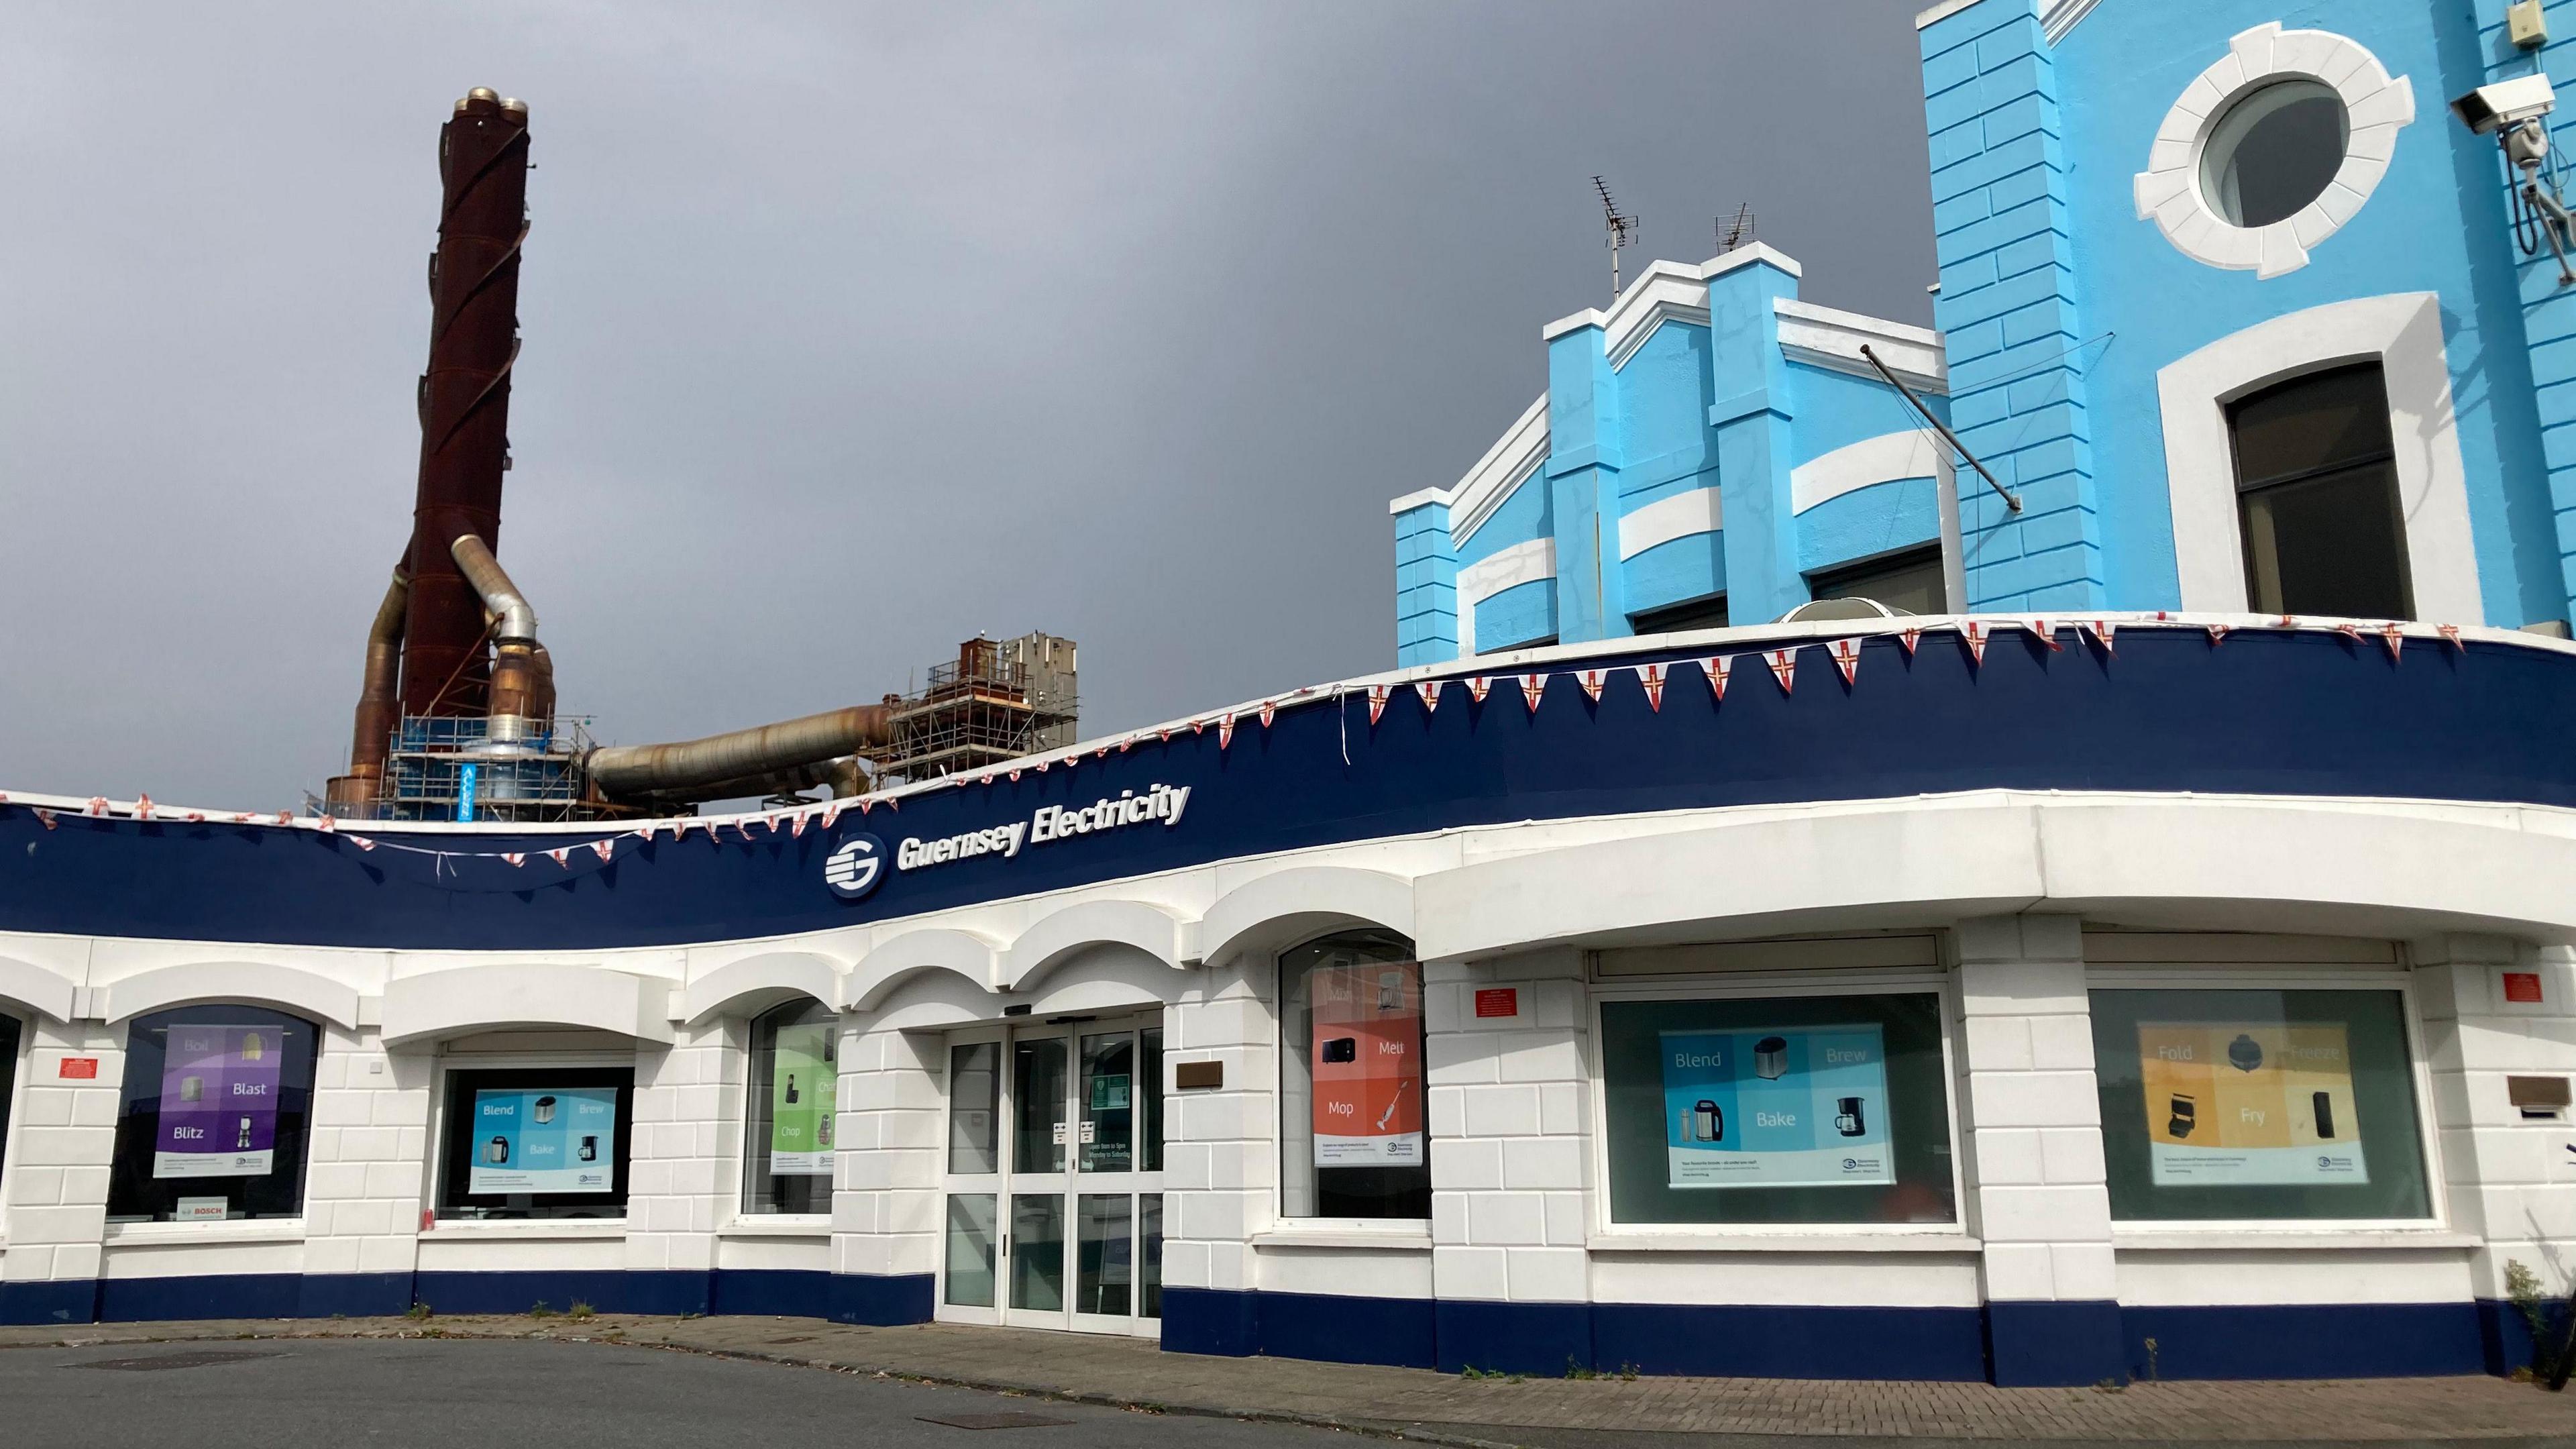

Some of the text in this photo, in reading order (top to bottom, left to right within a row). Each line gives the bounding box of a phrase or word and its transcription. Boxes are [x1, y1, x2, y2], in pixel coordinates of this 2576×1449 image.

[898, 784, 1191, 870] Guernsey Electricity
[184, 1040, 208, 1051] Boil
[1379, 1042, 1404, 1055] Melt
[1826, 1049, 1866, 1063] Brew
[2159, 1046, 2192, 1060] Fold
[1676, 1052, 1721, 1068] Blend
[233, 1083, 266, 1095] Blast
[484, 1106, 514, 1115] Blend
[579, 1104, 604, 1114] Brew
[1328, 1102, 1353, 1117] Mop
[1757, 1112, 1796, 1127] Bake
[2241, 1108, 2265, 1124] Fry
[174, 1126, 203, 1139] Blitz
[782, 1126, 800, 1138] Chop
[530, 1145, 554, 1155] Bake
[1112, 1151, 1131, 1159] Saturday
